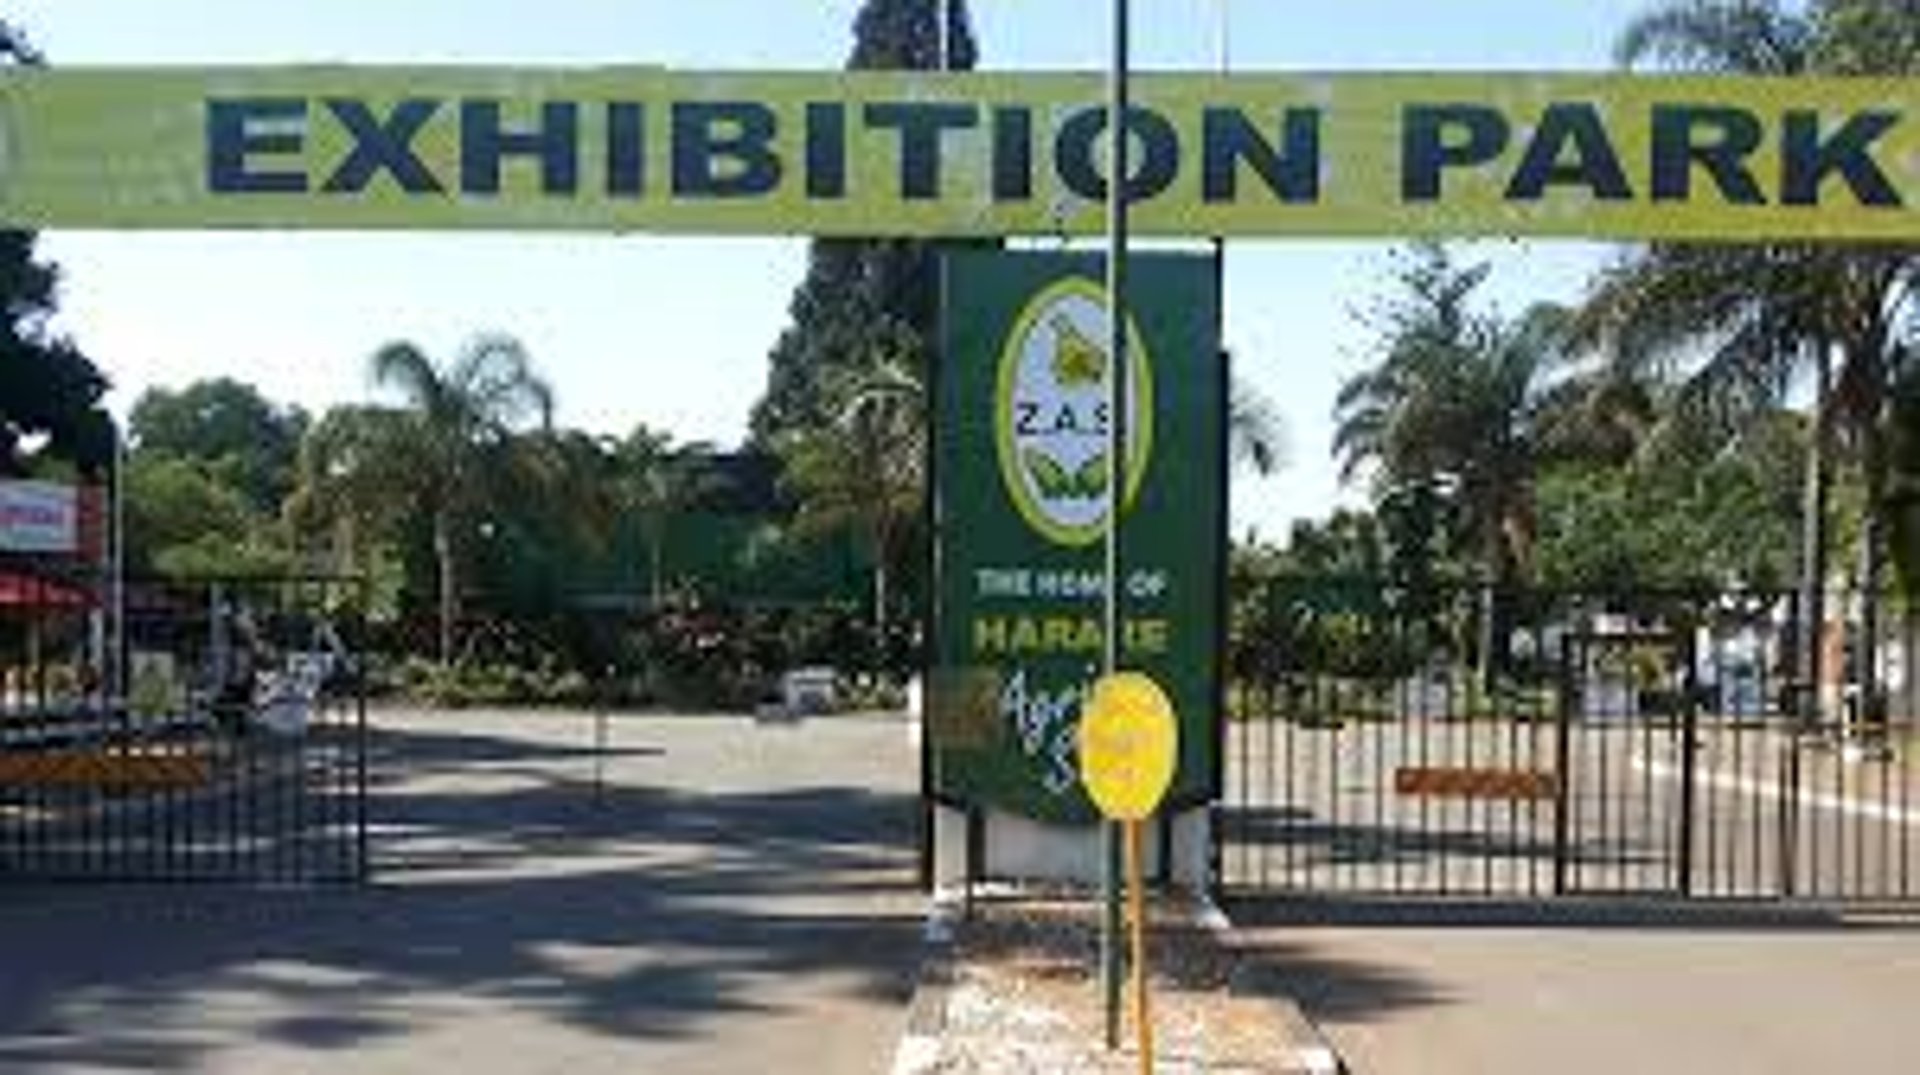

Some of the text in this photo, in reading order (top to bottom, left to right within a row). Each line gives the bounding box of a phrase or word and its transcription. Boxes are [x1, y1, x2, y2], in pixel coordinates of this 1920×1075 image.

[205, 98, 1904, 206] EXHIBITION PARK
[977, 569, 1166, 597] THE HOM OF
